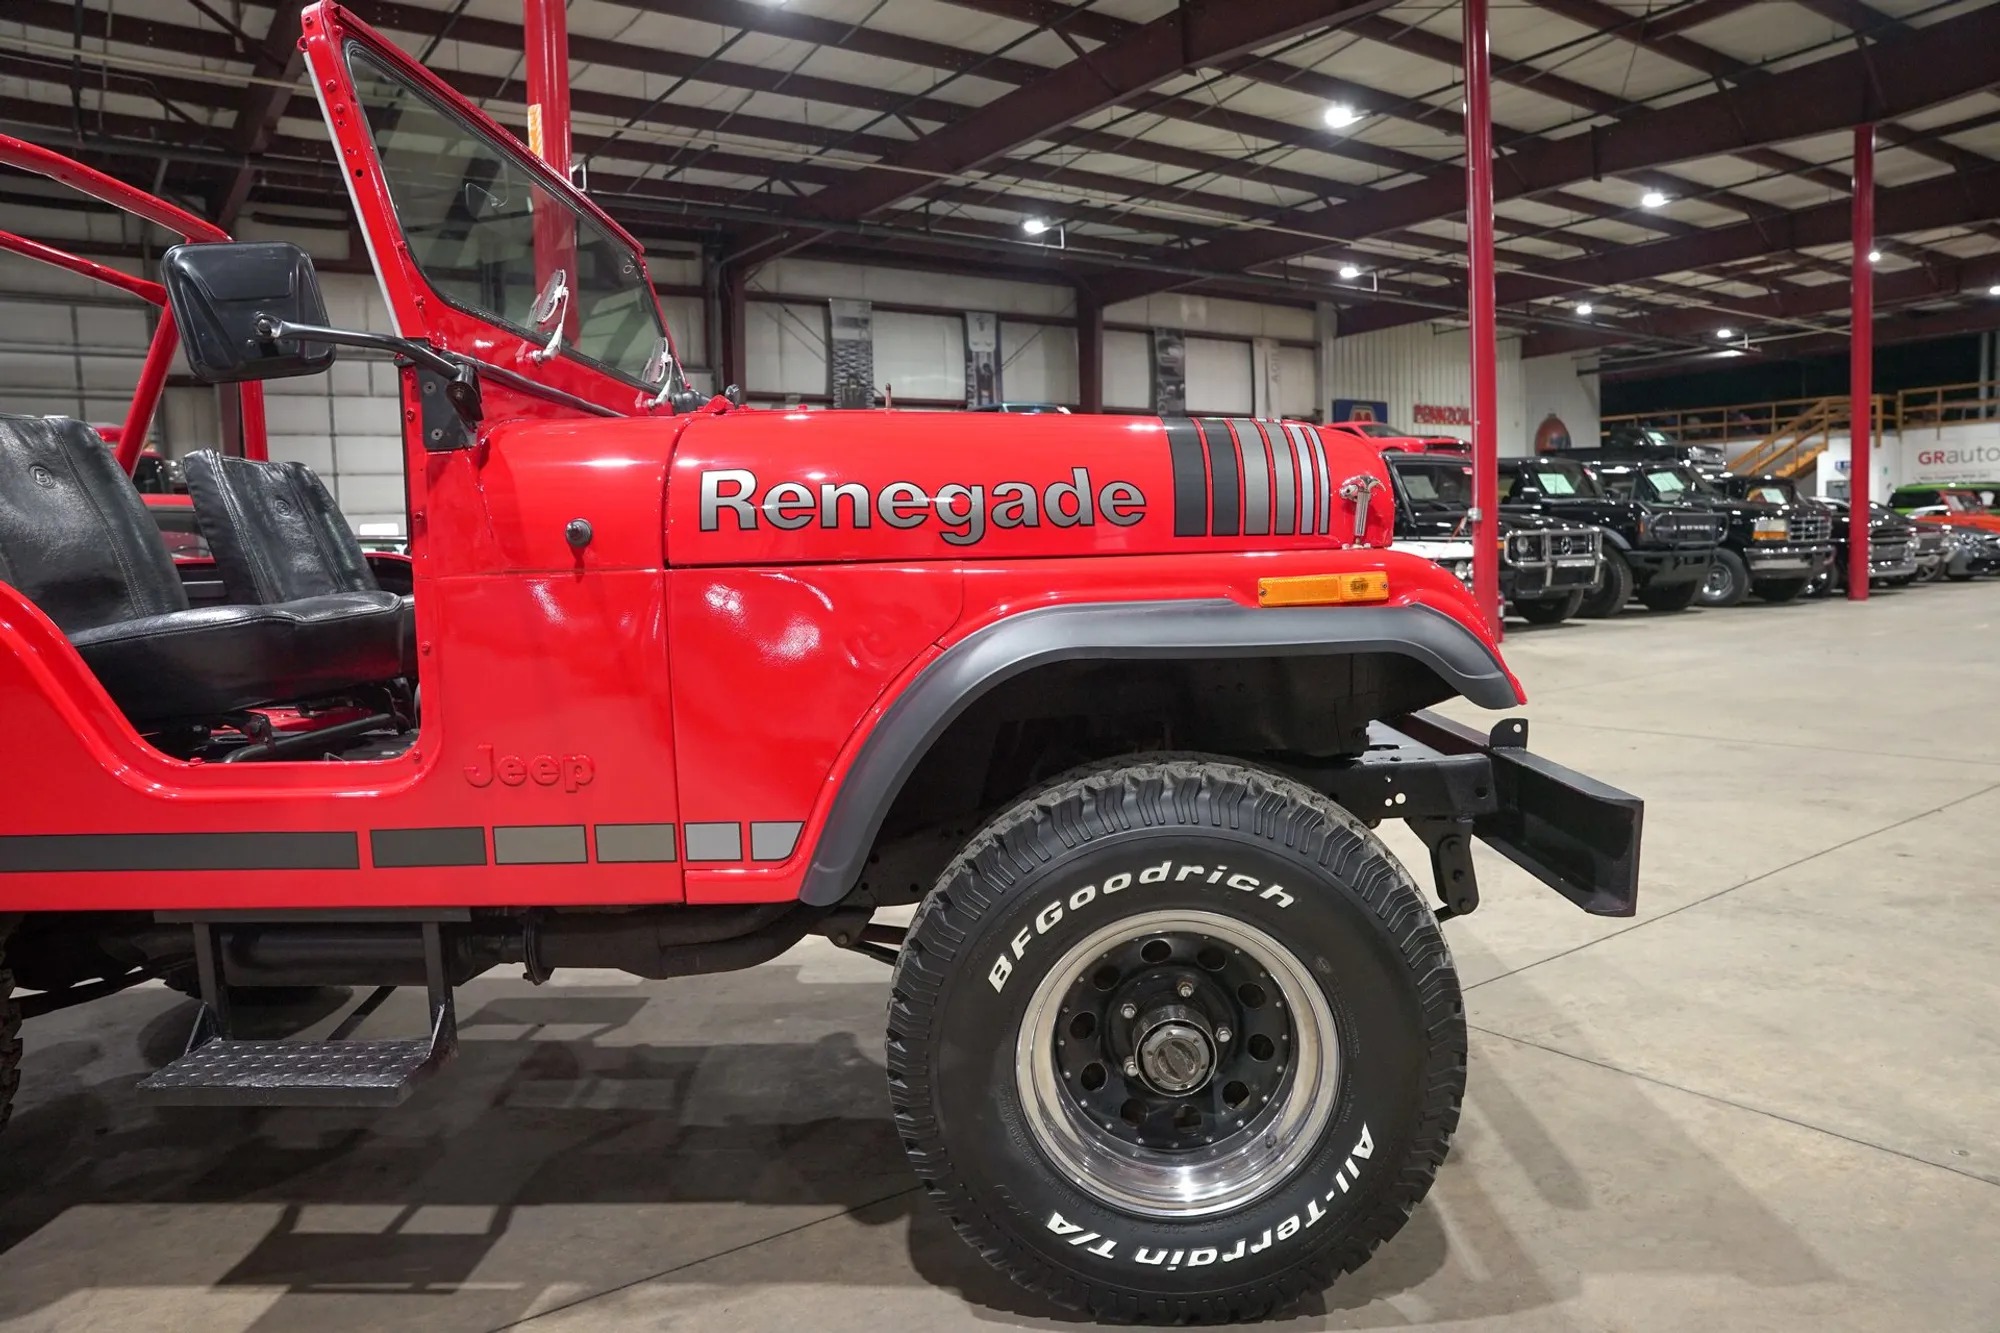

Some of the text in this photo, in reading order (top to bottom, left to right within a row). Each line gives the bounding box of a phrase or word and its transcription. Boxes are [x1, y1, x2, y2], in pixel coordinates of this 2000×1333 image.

[699, 466, 1147, 546] Renegade
[463, 743, 596, 794] Jeep
[987, 860, 1296, 994] BFGoodrich
[1045, 1210, 1119, 1260] T/A
[1134, 1121, 1376, 1272] All-Terrain
